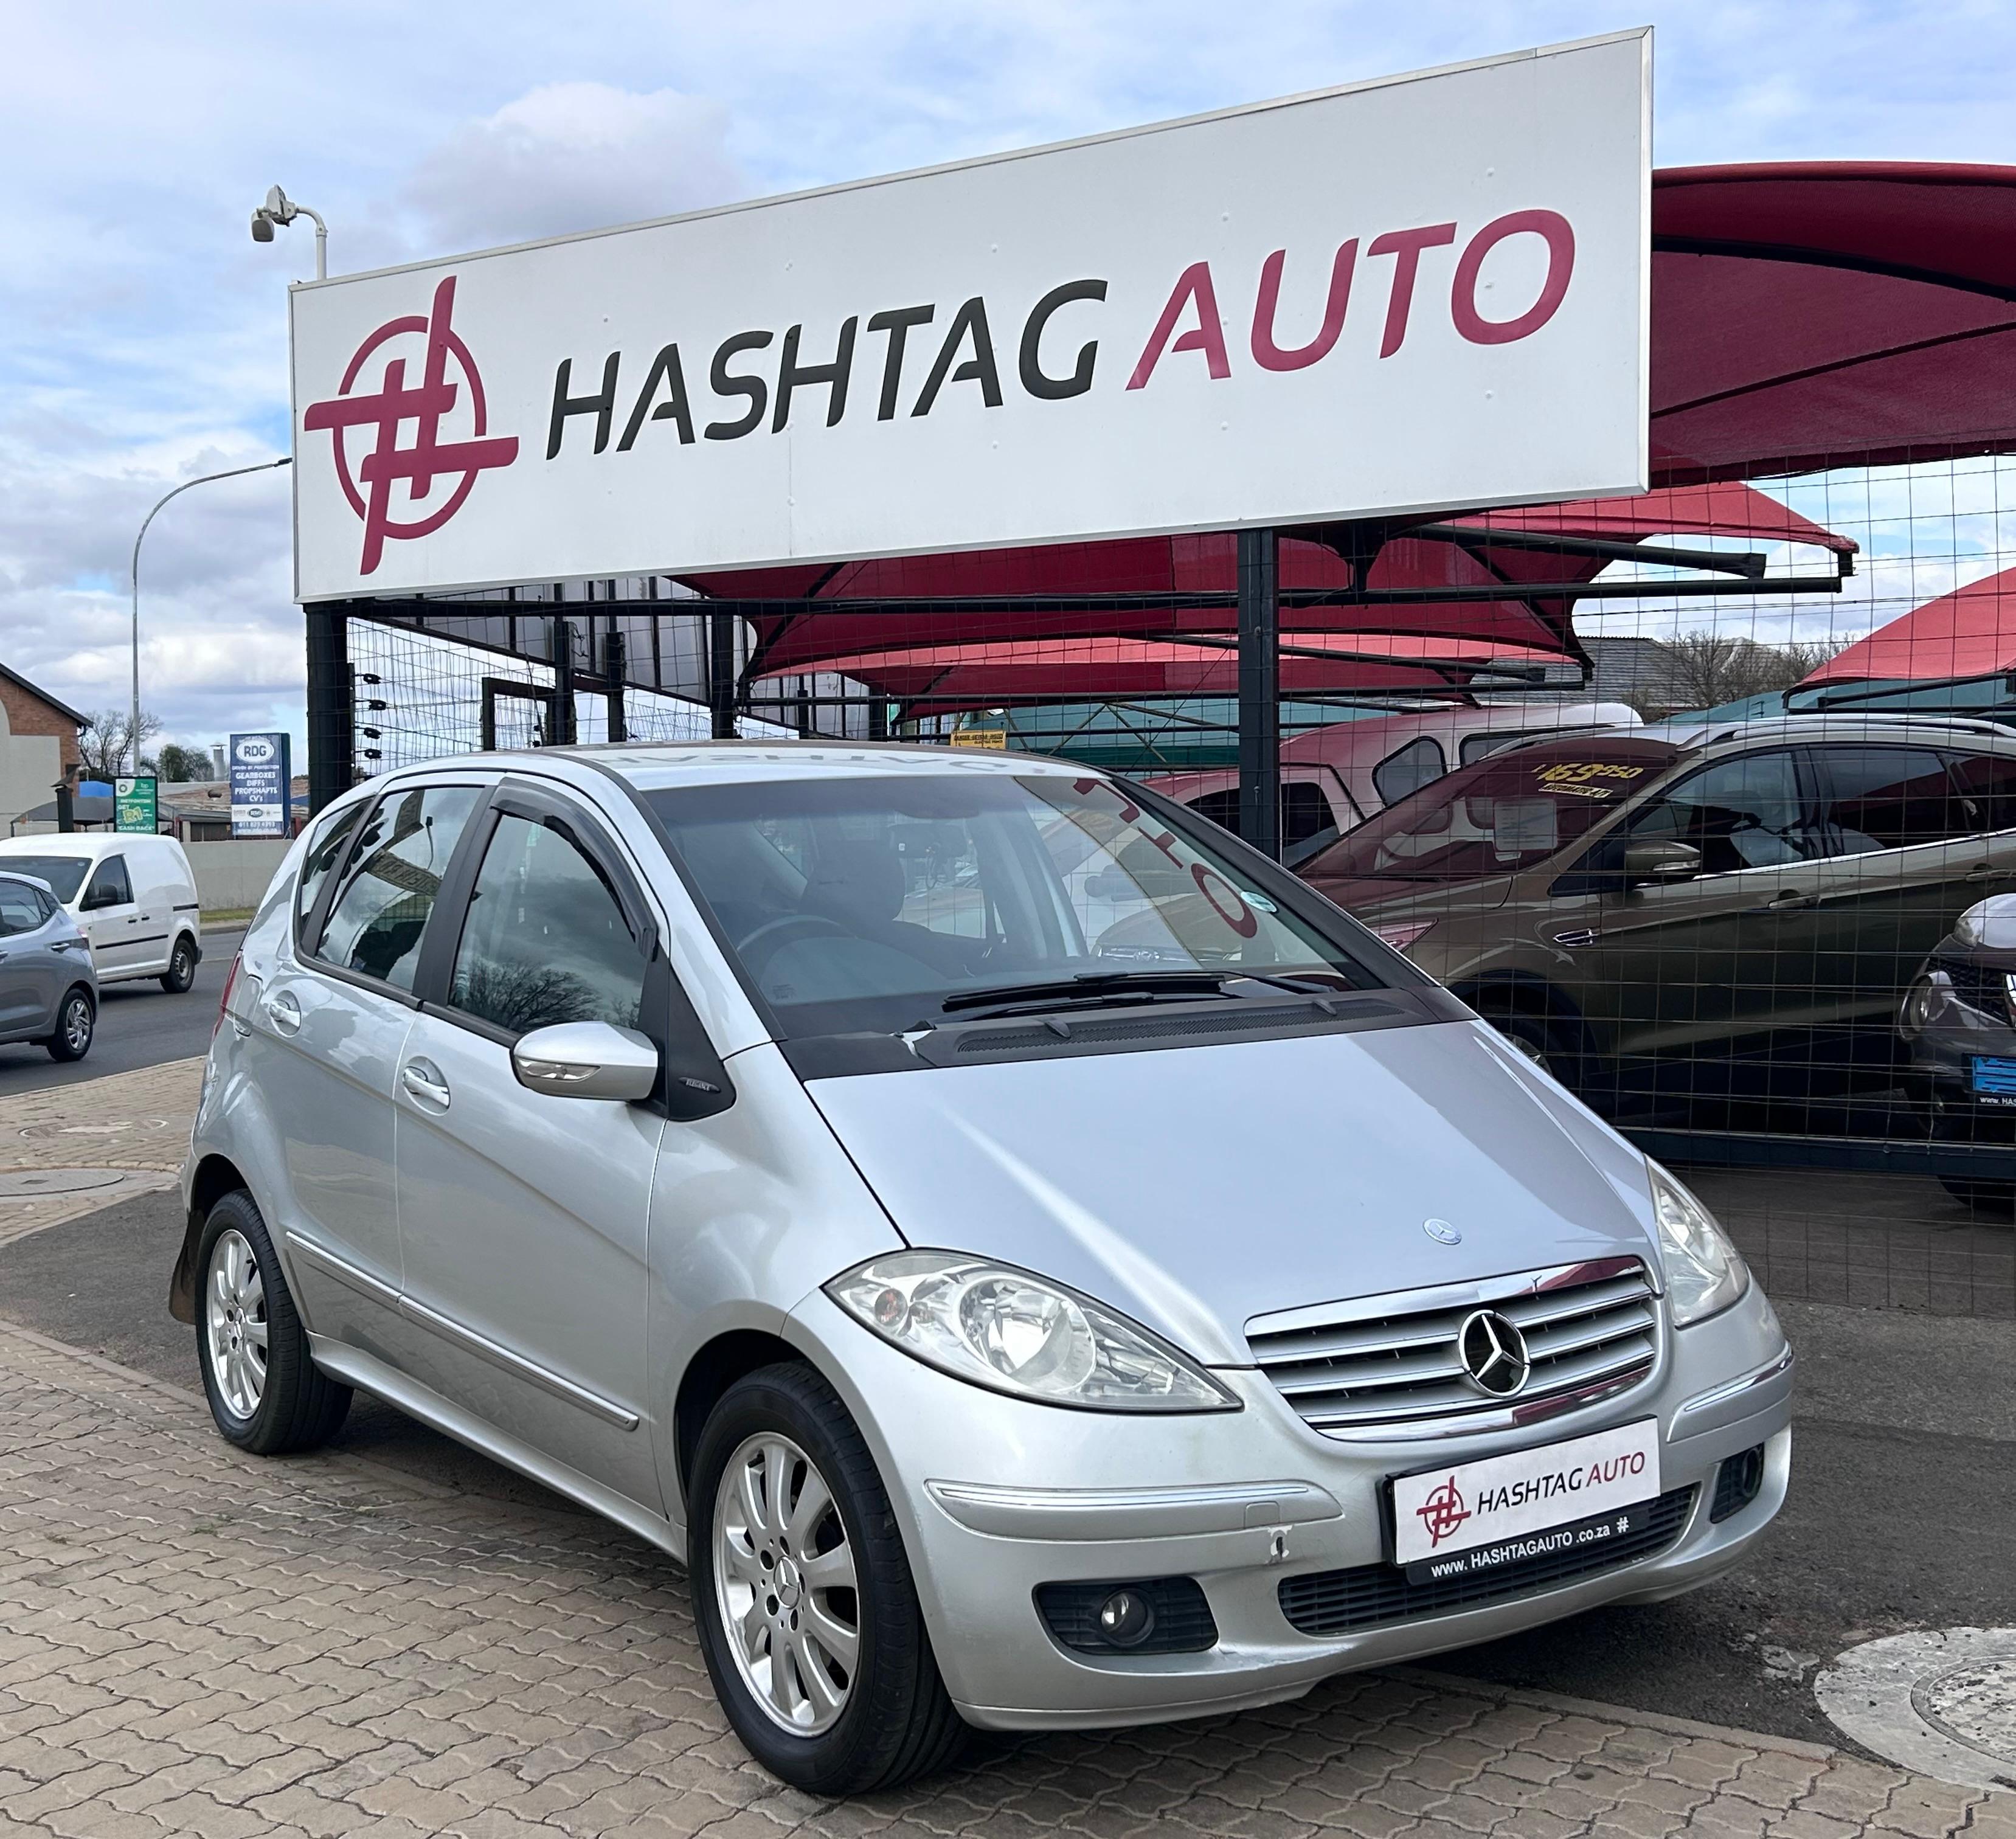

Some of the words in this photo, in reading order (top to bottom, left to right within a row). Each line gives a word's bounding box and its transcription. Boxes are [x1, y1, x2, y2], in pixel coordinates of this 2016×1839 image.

[546, 279, 1108, 460] HASHTAG
[1126, 210, 1575, 390] AUTO
[244, 746, 266, 757] RDG
[1477, 1467, 1584, 1515] HASHTAG
[1586, 1451, 1646, 1487] AUTO
[1431, 1559, 1468, 1578] www.
[1470, 1531, 1573, 1568] HASHTAGAUTO
